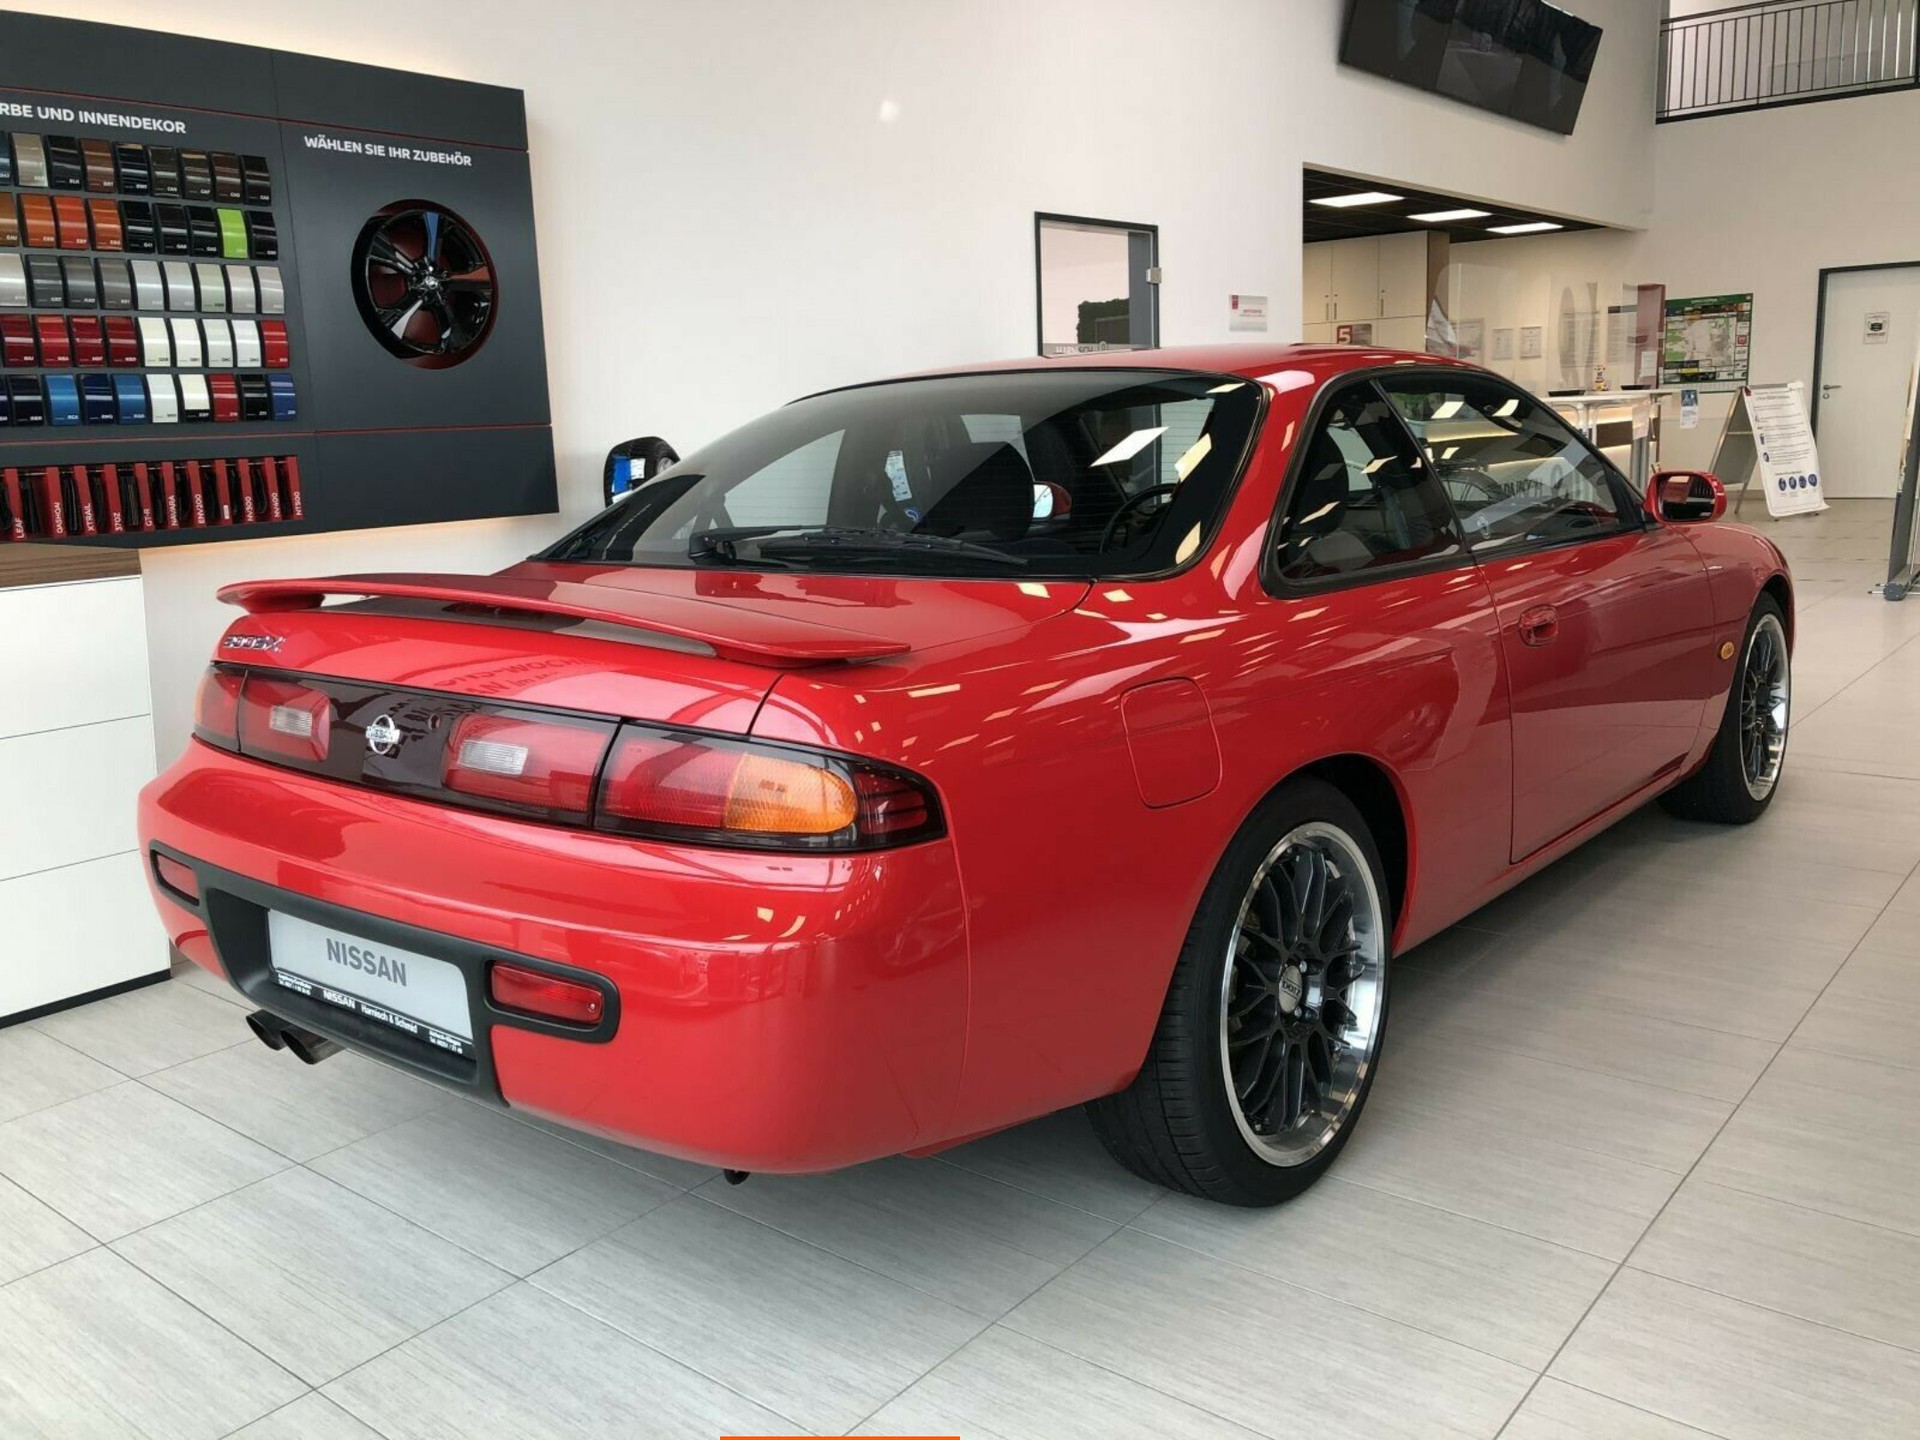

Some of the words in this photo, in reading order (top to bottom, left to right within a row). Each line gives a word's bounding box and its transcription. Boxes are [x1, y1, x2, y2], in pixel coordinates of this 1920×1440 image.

[37, 106, 75, 122] UND
[78, 110, 187, 134] INNENDEKOR
[304, 134, 362, 153] WÄHLEN
[365, 143, 386, 157] SIE
[388, 146, 410, 160] IHR
[412, 150, 472, 166] ZUBEHÖR
[1339, 328, 1350, 344] 5
[84, 503, 95, 531] XTRAIL
[113, 512, 123, 532] 370Z
[144, 508, 153, 527] GT-R
[168, 495, 178, 527] NAVARA
[195, 494, 205, 524] ENV200
[15, 517, 25, 539] LEAF
[326, 937, 407, 987] NISSAN
[323, 989, 356, 1010] NISSAN
[361, 1003, 388, 1021] Harnisch
[395, 1015, 418, 1034] Schmid
